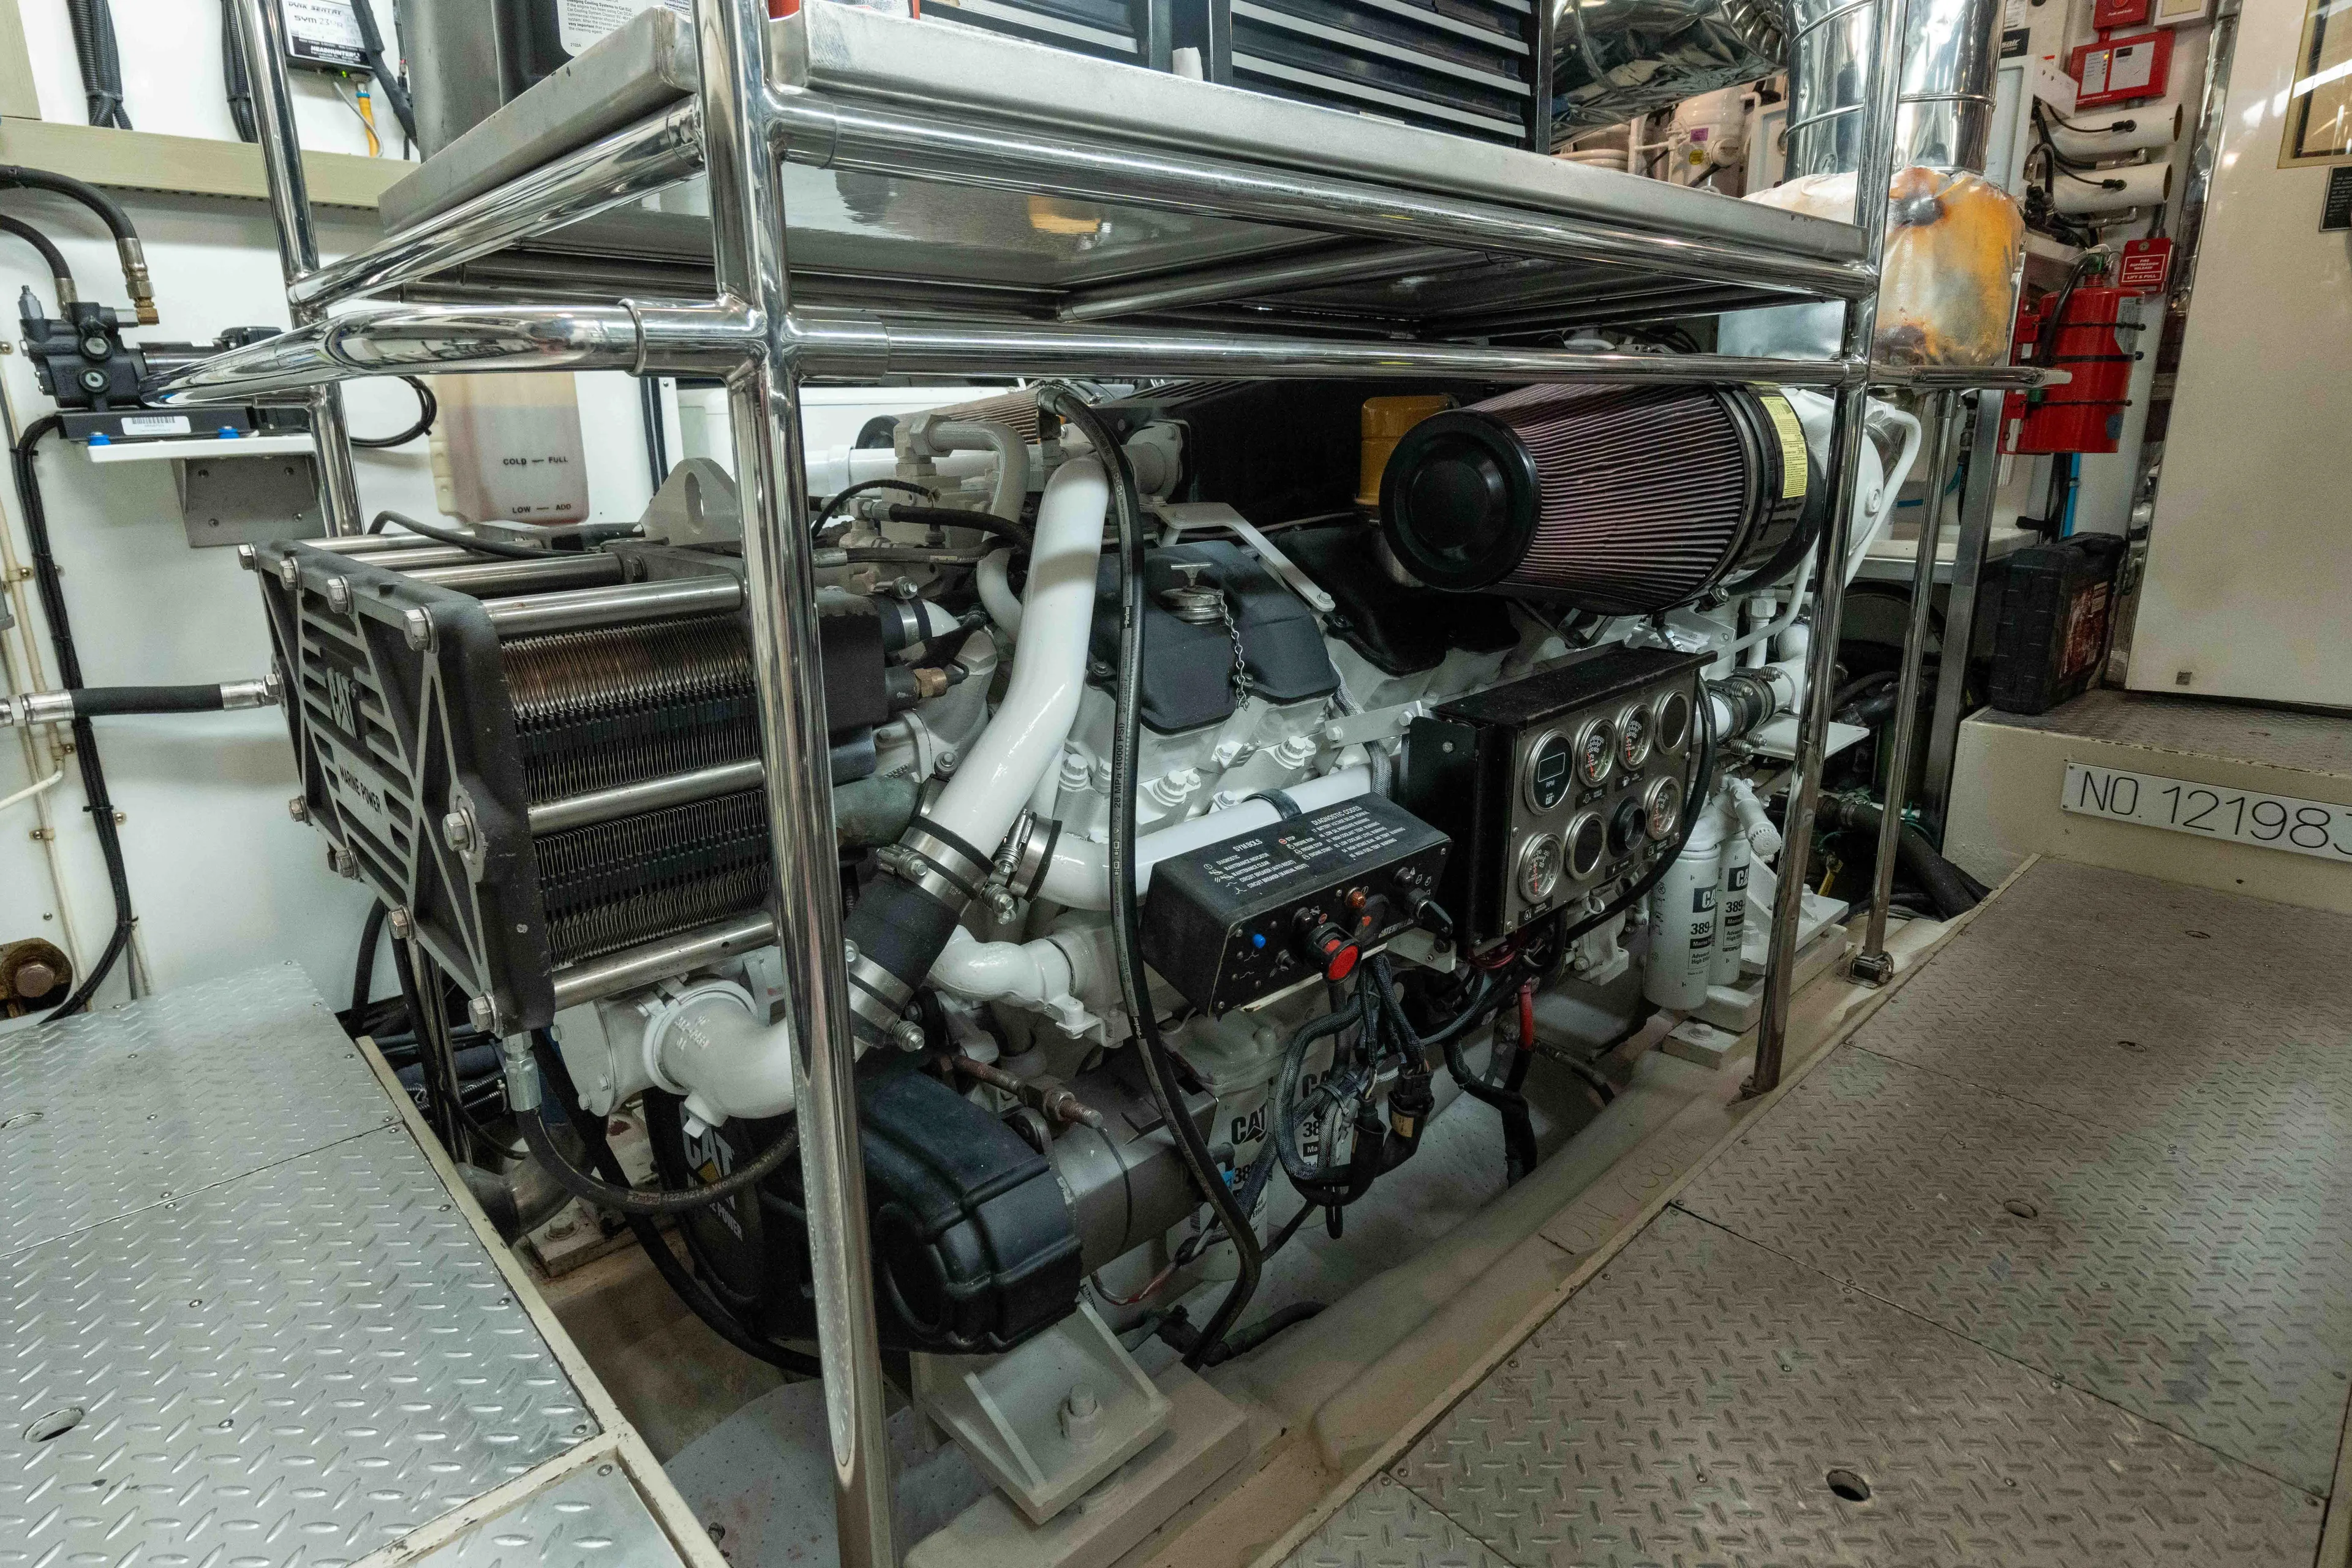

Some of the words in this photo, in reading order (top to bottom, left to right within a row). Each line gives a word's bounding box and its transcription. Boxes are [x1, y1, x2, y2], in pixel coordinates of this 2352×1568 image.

[327, 666, 358, 741] CAT
[339, 765, 361, 797] MARINE
[360, 782, 382, 816] POWER
[1546, 780, 1555, 788] RPM
[2080, 771, 2142, 818] NO.
[1114, 797, 1121, 809] 28
[1311, 812, 1345, 826] DIAGNOSTIC
[1343, 805, 1362, 815] CODES
[1337, 823, 1356, 832] PRESSURE
[1232, 839, 1263, 852] SYMBOLS
[1347, 835, 1363, 843] COOLANT
[1216, 854, 1240, 865] DIAGNOSTIC
[1224, 859, 1251, 870] MAINTENANCE
[1249, 853, 1270, 862] INDICATOR
[1231, 864, 1259, 876] MAINTENANCE
[1239, 873, 1256, 882] CIRCUIT
[1253, 868, 1273, 877] BREAKER
[1247, 880, 1264, 888] CIRCUIT
[1261, 873, 1281, 883] BREAKER
[1278, 867, 1297, 878] (MANUAL
[1231, 1103, 1267, 1145] CAT
[717, 1202, 743, 1242] POWER
